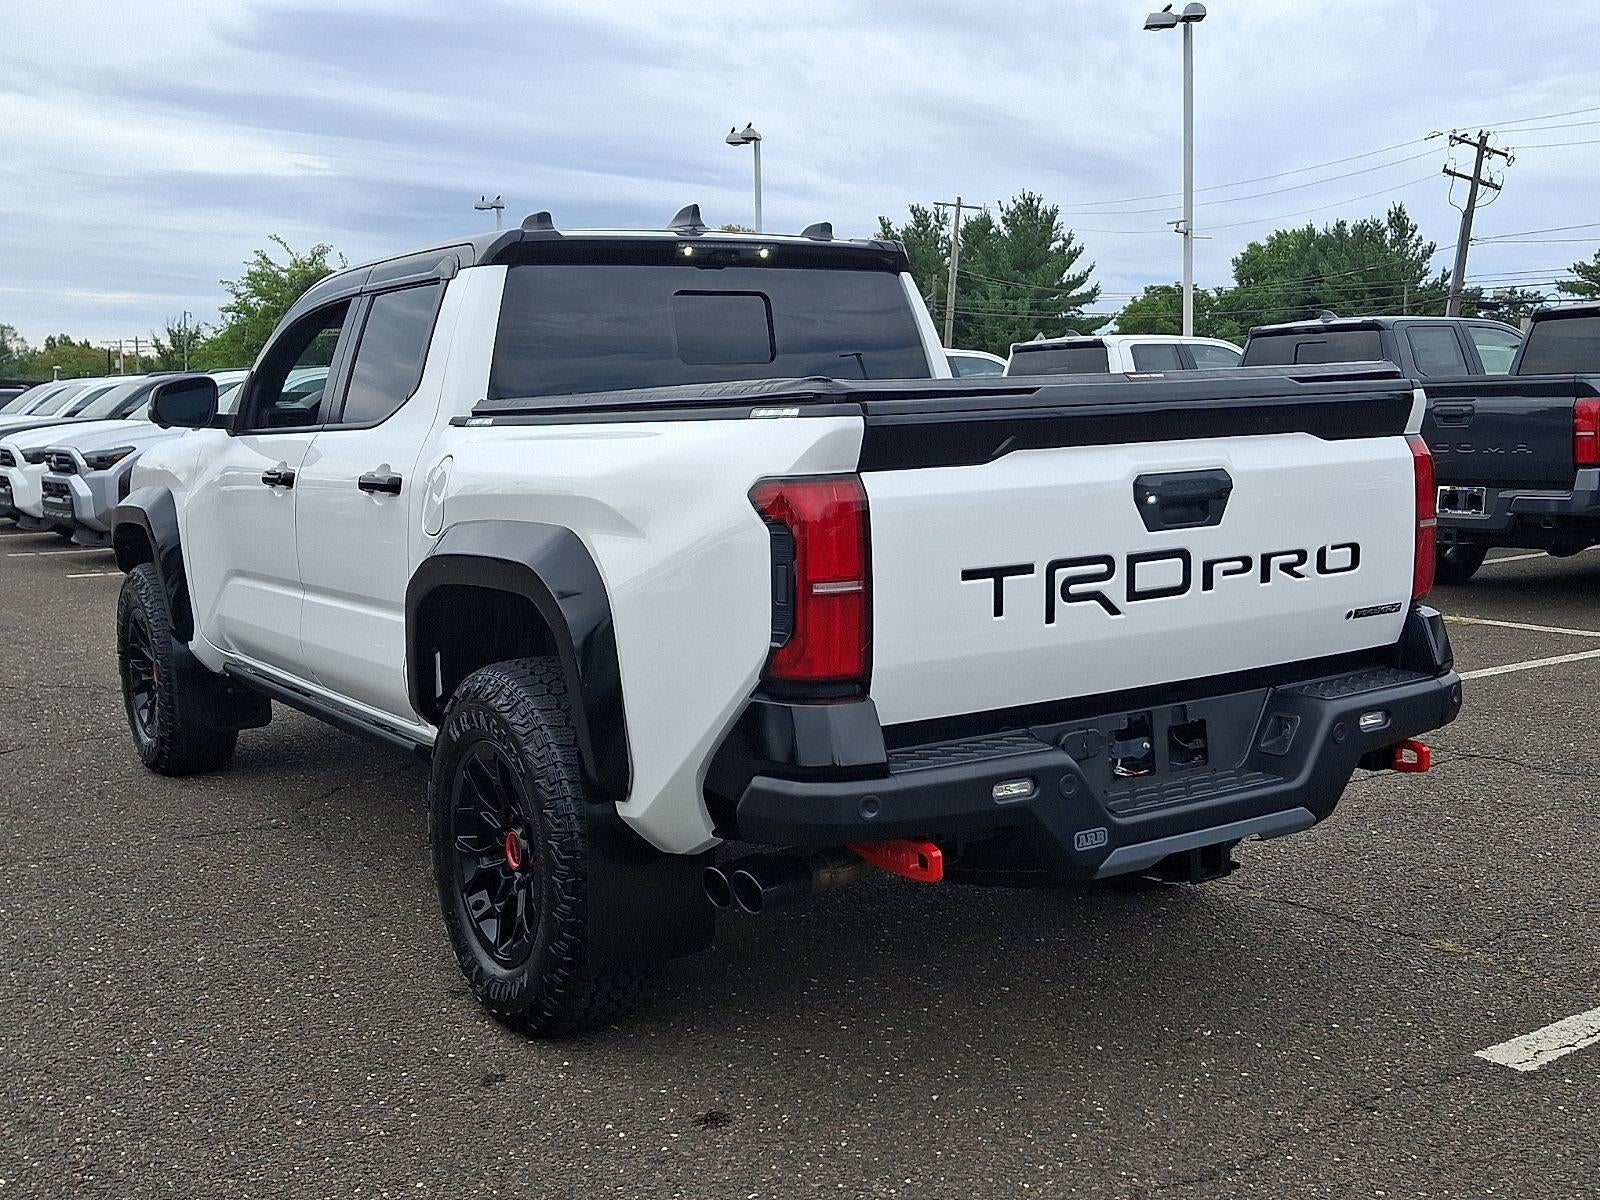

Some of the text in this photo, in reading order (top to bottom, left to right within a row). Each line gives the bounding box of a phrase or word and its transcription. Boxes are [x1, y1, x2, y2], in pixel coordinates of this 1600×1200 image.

[1431, 442, 1533, 454] COMA
[960, 541, 1361, 625] TRD PRO
[1078, 831, 1105, 847] ARB
